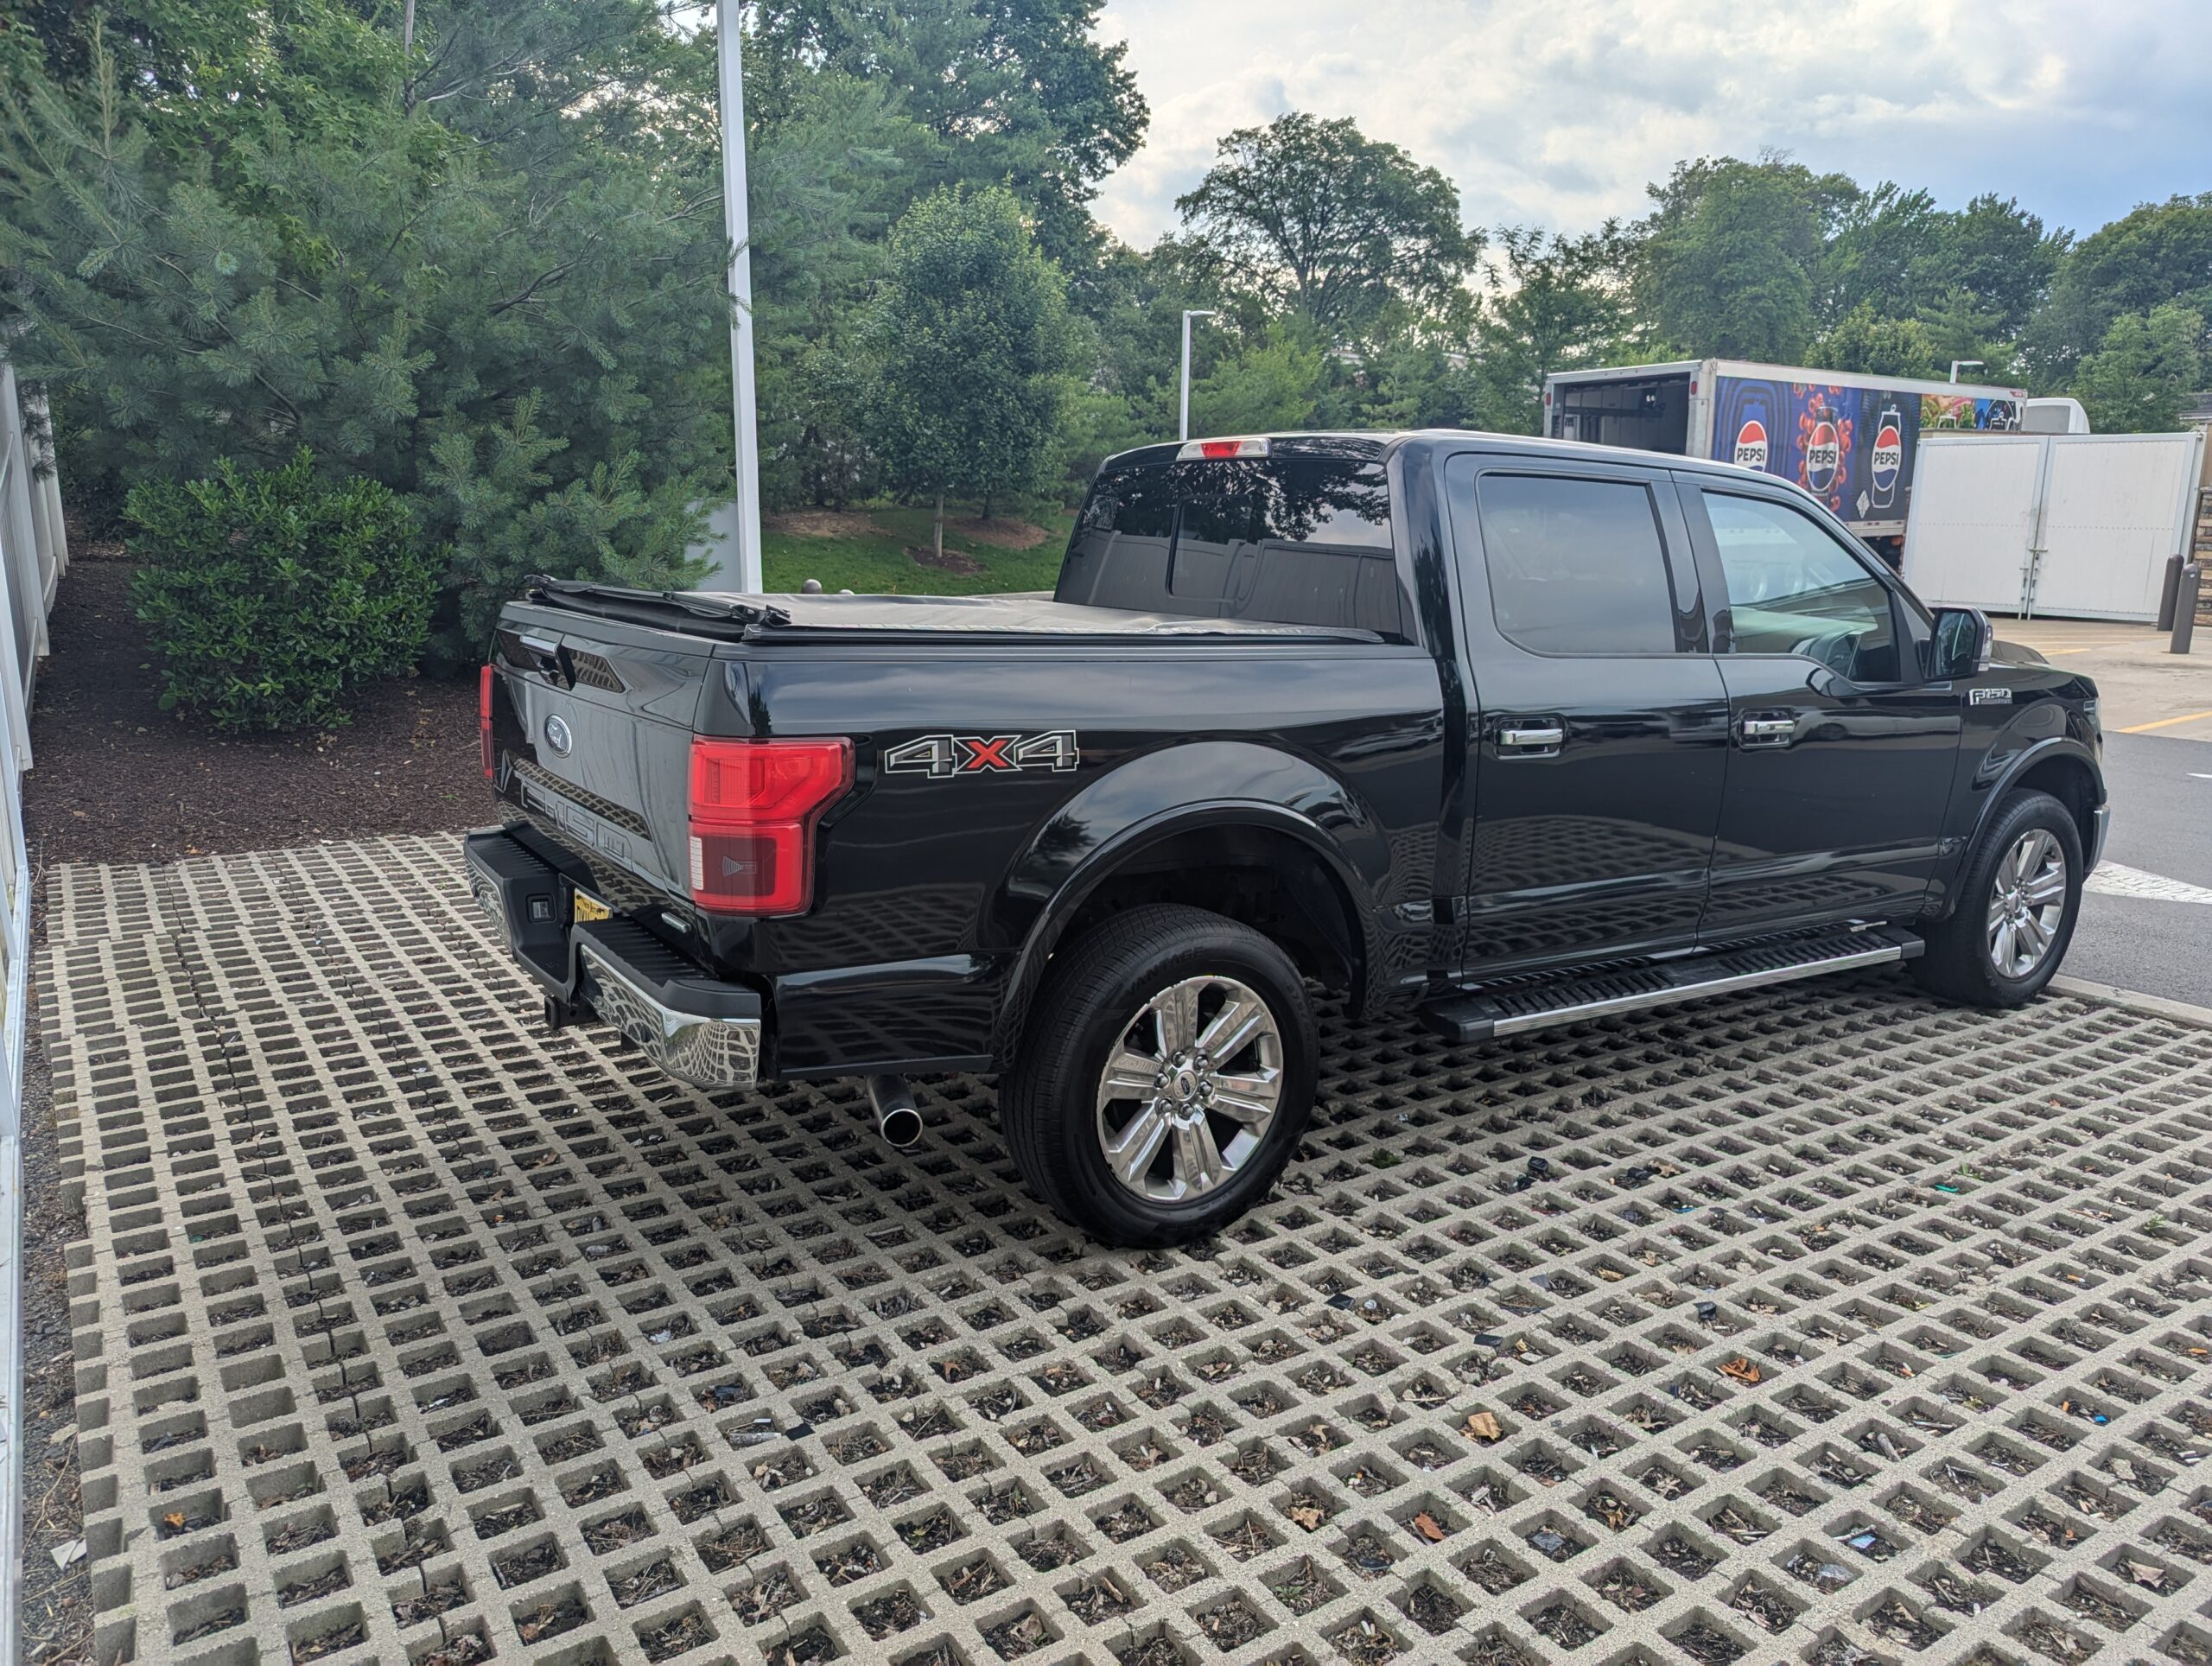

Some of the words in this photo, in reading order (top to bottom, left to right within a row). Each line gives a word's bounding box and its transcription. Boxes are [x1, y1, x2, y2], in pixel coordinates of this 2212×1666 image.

[1737, 448, 1765, 462] PEPSI
[1808, 449, 1837, 464] PEPSI
[1873, 451, 1899, 466] PEPSI
